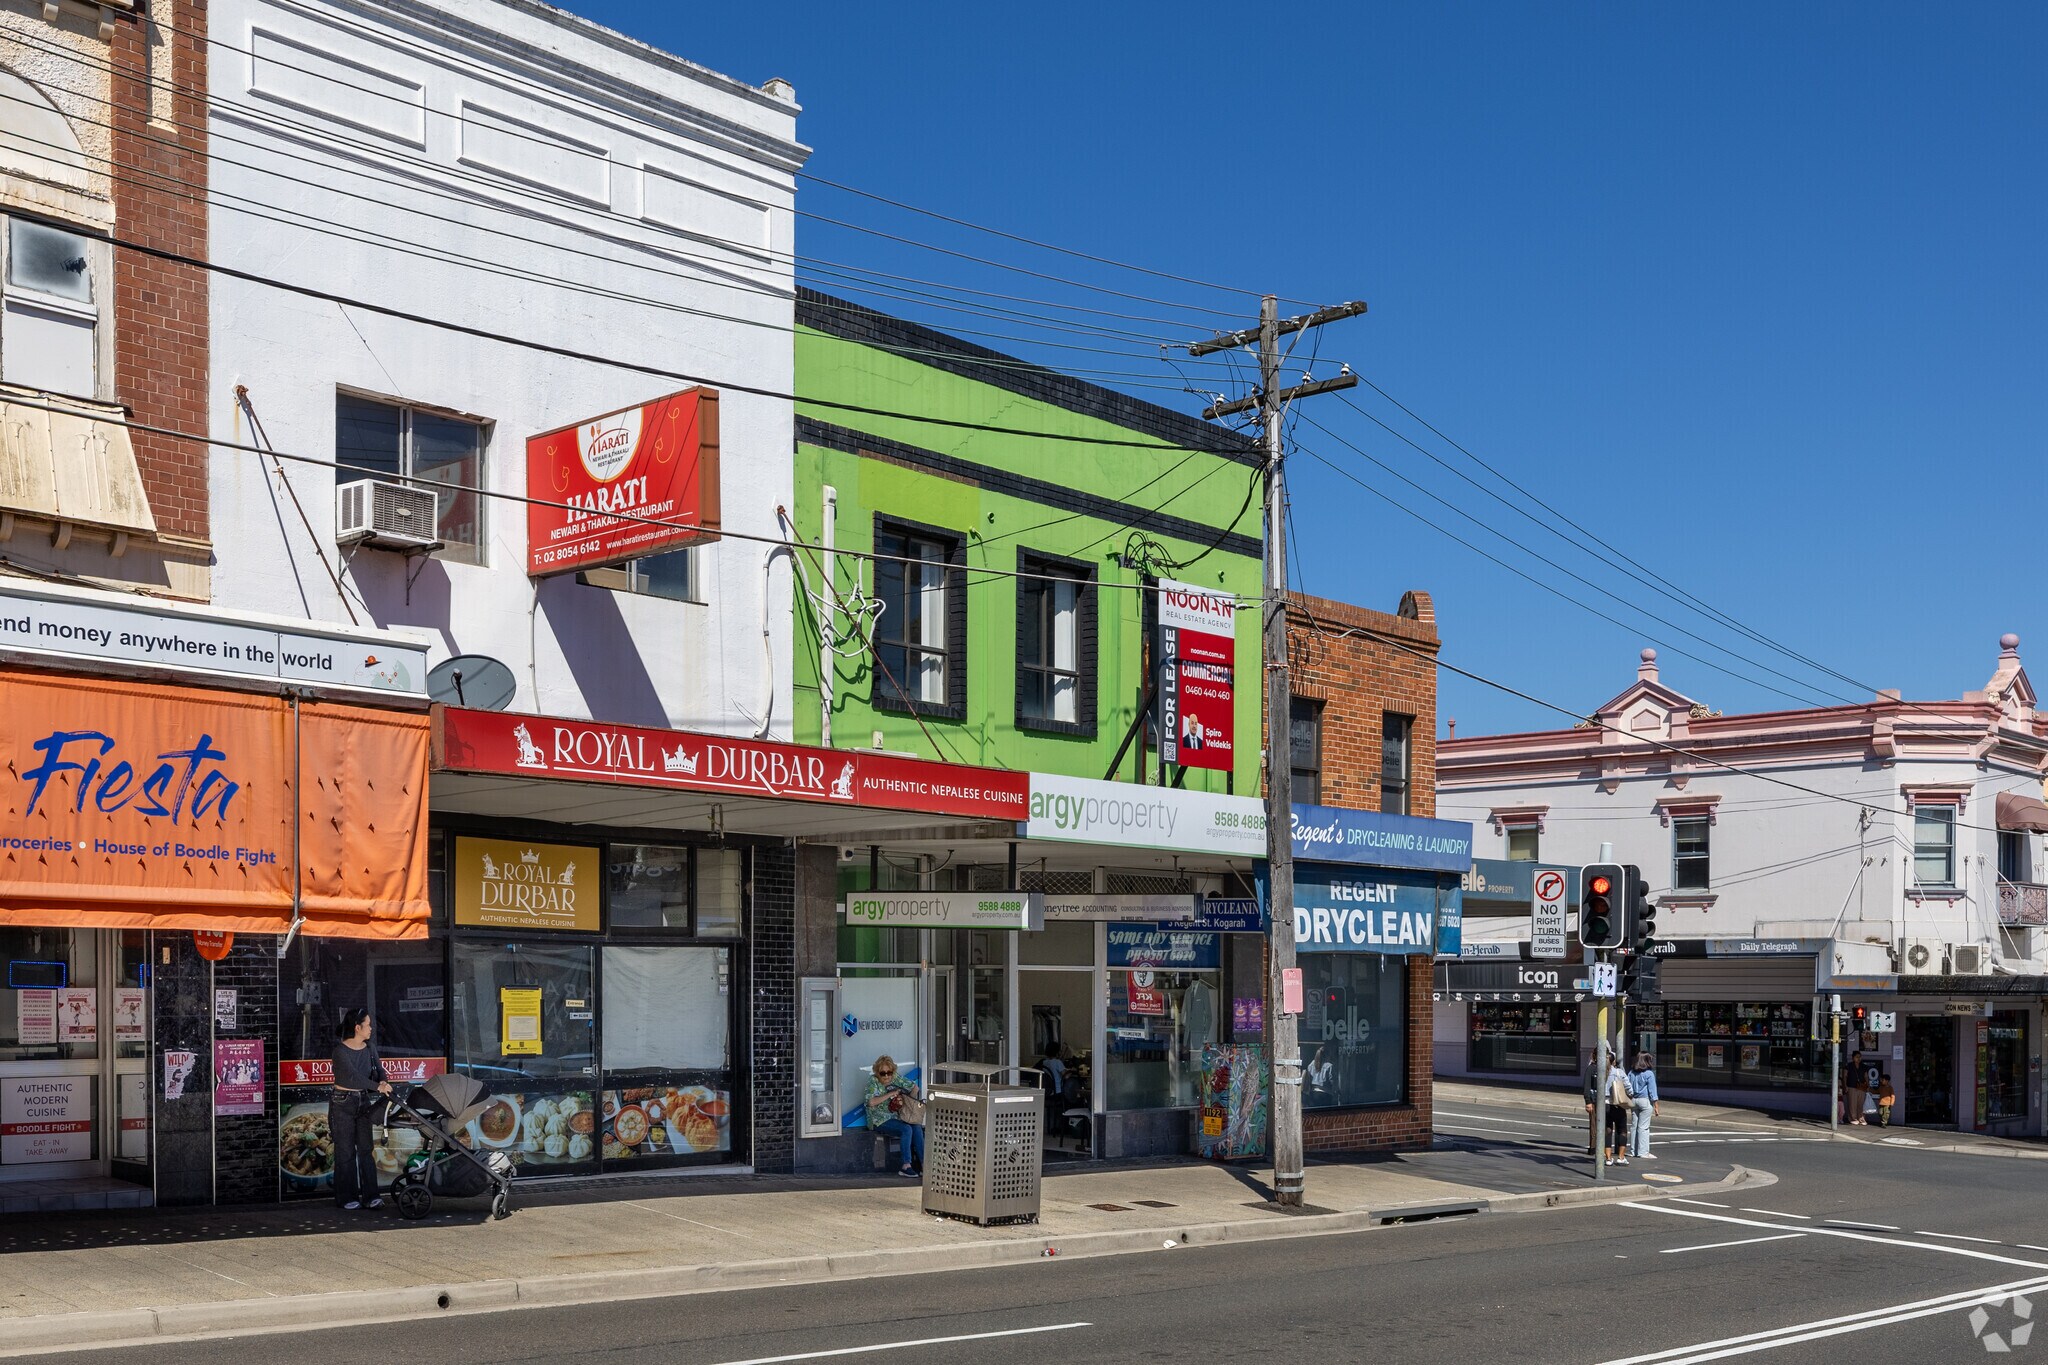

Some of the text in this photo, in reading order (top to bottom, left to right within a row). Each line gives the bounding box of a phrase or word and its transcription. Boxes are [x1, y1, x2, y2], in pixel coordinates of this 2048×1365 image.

[566, 476, 647, 524] HARATI
[551, 524, 580, 540] NEWARI
[580, 523, 587, 532] &
[620, 500, 674, 521] RESTAURANT
[534, 554, 542, 565] T:
[543, 551, 554, 562] 02
[556, 546, 578, 560] 8054
[580, 540, 600, 553] 6142
[1166, 590, 1231, 618] NOONAN
[1166, 611, 1232, 629] REAL ESTATE AGENCY
[39, 622, 112, 646] money
[120, 632, 217, 656] anywhere
[223, 641, 240, 659] in
[246, 645, 275, 664] the
[282, 653, 333, 671] world
[1190, 648, 1226, 659] noonan.com.au
[1182, 661, 1232, 685] COMMERCIAL
[1166, 629, 1176, 739] FOR LEASE
[1185, 685, 1231, 701] 0460 440 460
[1205, 728, 1222, 737] Spiro
[1205, 739, 1232, 750] Veldekis
[553, 727, 825, 795] ROYAL DURBAR
[22, 730, 240, 826] Fiesta
[863, 777, 1023, 804] AUTHENTIC NEPALESE CUISINE
[1030, 790, 1265, 838] argyproperty 9588 4888
[1206, 826, 1265, 841] argyproperty.com.au
[1291, 813, 1470, 855] Regent's DRYCLEANING & LAUNDRY
[94, 838, 147, 855] House
[152, 842, 170, 857] of
[175, 843, 230, 860] Boodle
[236, 848, 276, 866] Fight
[504, 862, 556, 884] ROYAL
[1461, 864, 1514, 895] elle PROPERTY
[481, 881, 575, 916] DURBAR
[1330, 880, 1397, 904] REGENT
[853, 897, 1021, 921] argyproperty 9588 4888
[971, 911, 1021, 919] argyproperty.com.au
[1043, 904, 1080, 916] oneytree
[1204, 902, 1260, 915] RYCLEANIN
[1540, 904, 1558, 915] NO
[480, 915, 518, 924] AUTHENTIC
[520, 918, 549, 926] NEPALESE
[1202, 917, 1212, 927] St.
[1214, 918, 1246, 930] Kogarah
[1294, 908, 1432, 946] DRYCLEAN
[1447, 916, 1460, 928] 6020
[1536, 917, 1561, 926] RIGHT
[1108, 931, 1214, 945] SAME DAY SERVICE
[1653, 941, 1676, 954] erald
[1740, 942, 1798, 952] Daily Telegraph
[1518, 966, 1558, 984] icon
[858, 1020, 903, 1031] NEW EDGE GROUP
[1322, 1005, 1370, 1041] belle
[312, 1060, 411, 1075] ROY RBAR
[17, 1083, 73, 1093] AUTHENTIC
[23, 1096, 69, 1105] MODERN
[27, 1108, 66, 1117] CUISINE
[1206, 1108, 1221, 1117] 1192
[16, 1123, 77, 1133] BOODLE FIGHT
